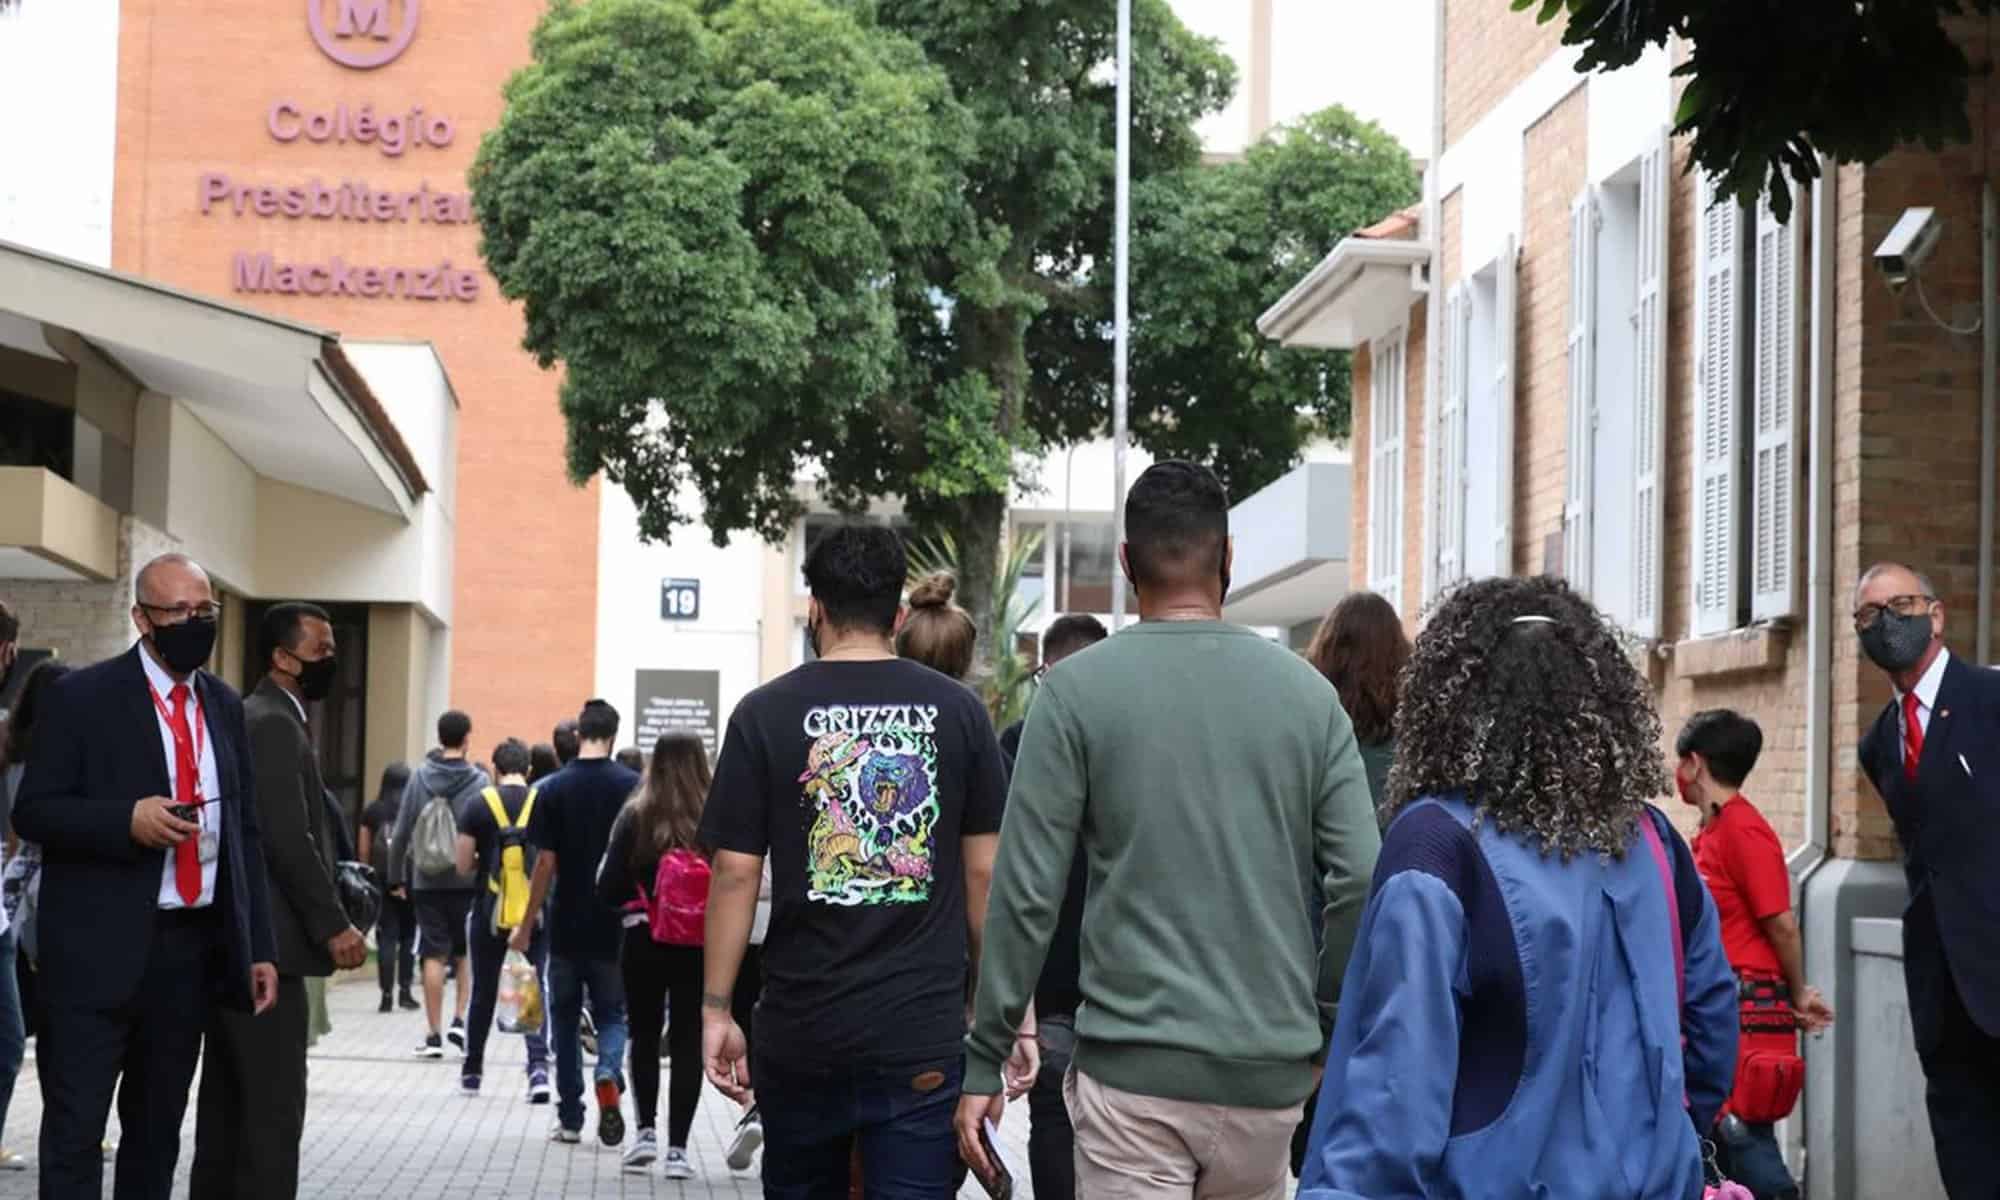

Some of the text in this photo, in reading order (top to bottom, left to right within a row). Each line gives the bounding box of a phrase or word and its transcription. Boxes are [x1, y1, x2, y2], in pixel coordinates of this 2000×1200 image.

[333, 0, 390, 40] M
[268, 101, 456, 158] Colégio
[232, 252, 480, 302] Mackenzie
[665, 588, 696, 615] 19
[803, 704, 939, 738] GRIZZLY
